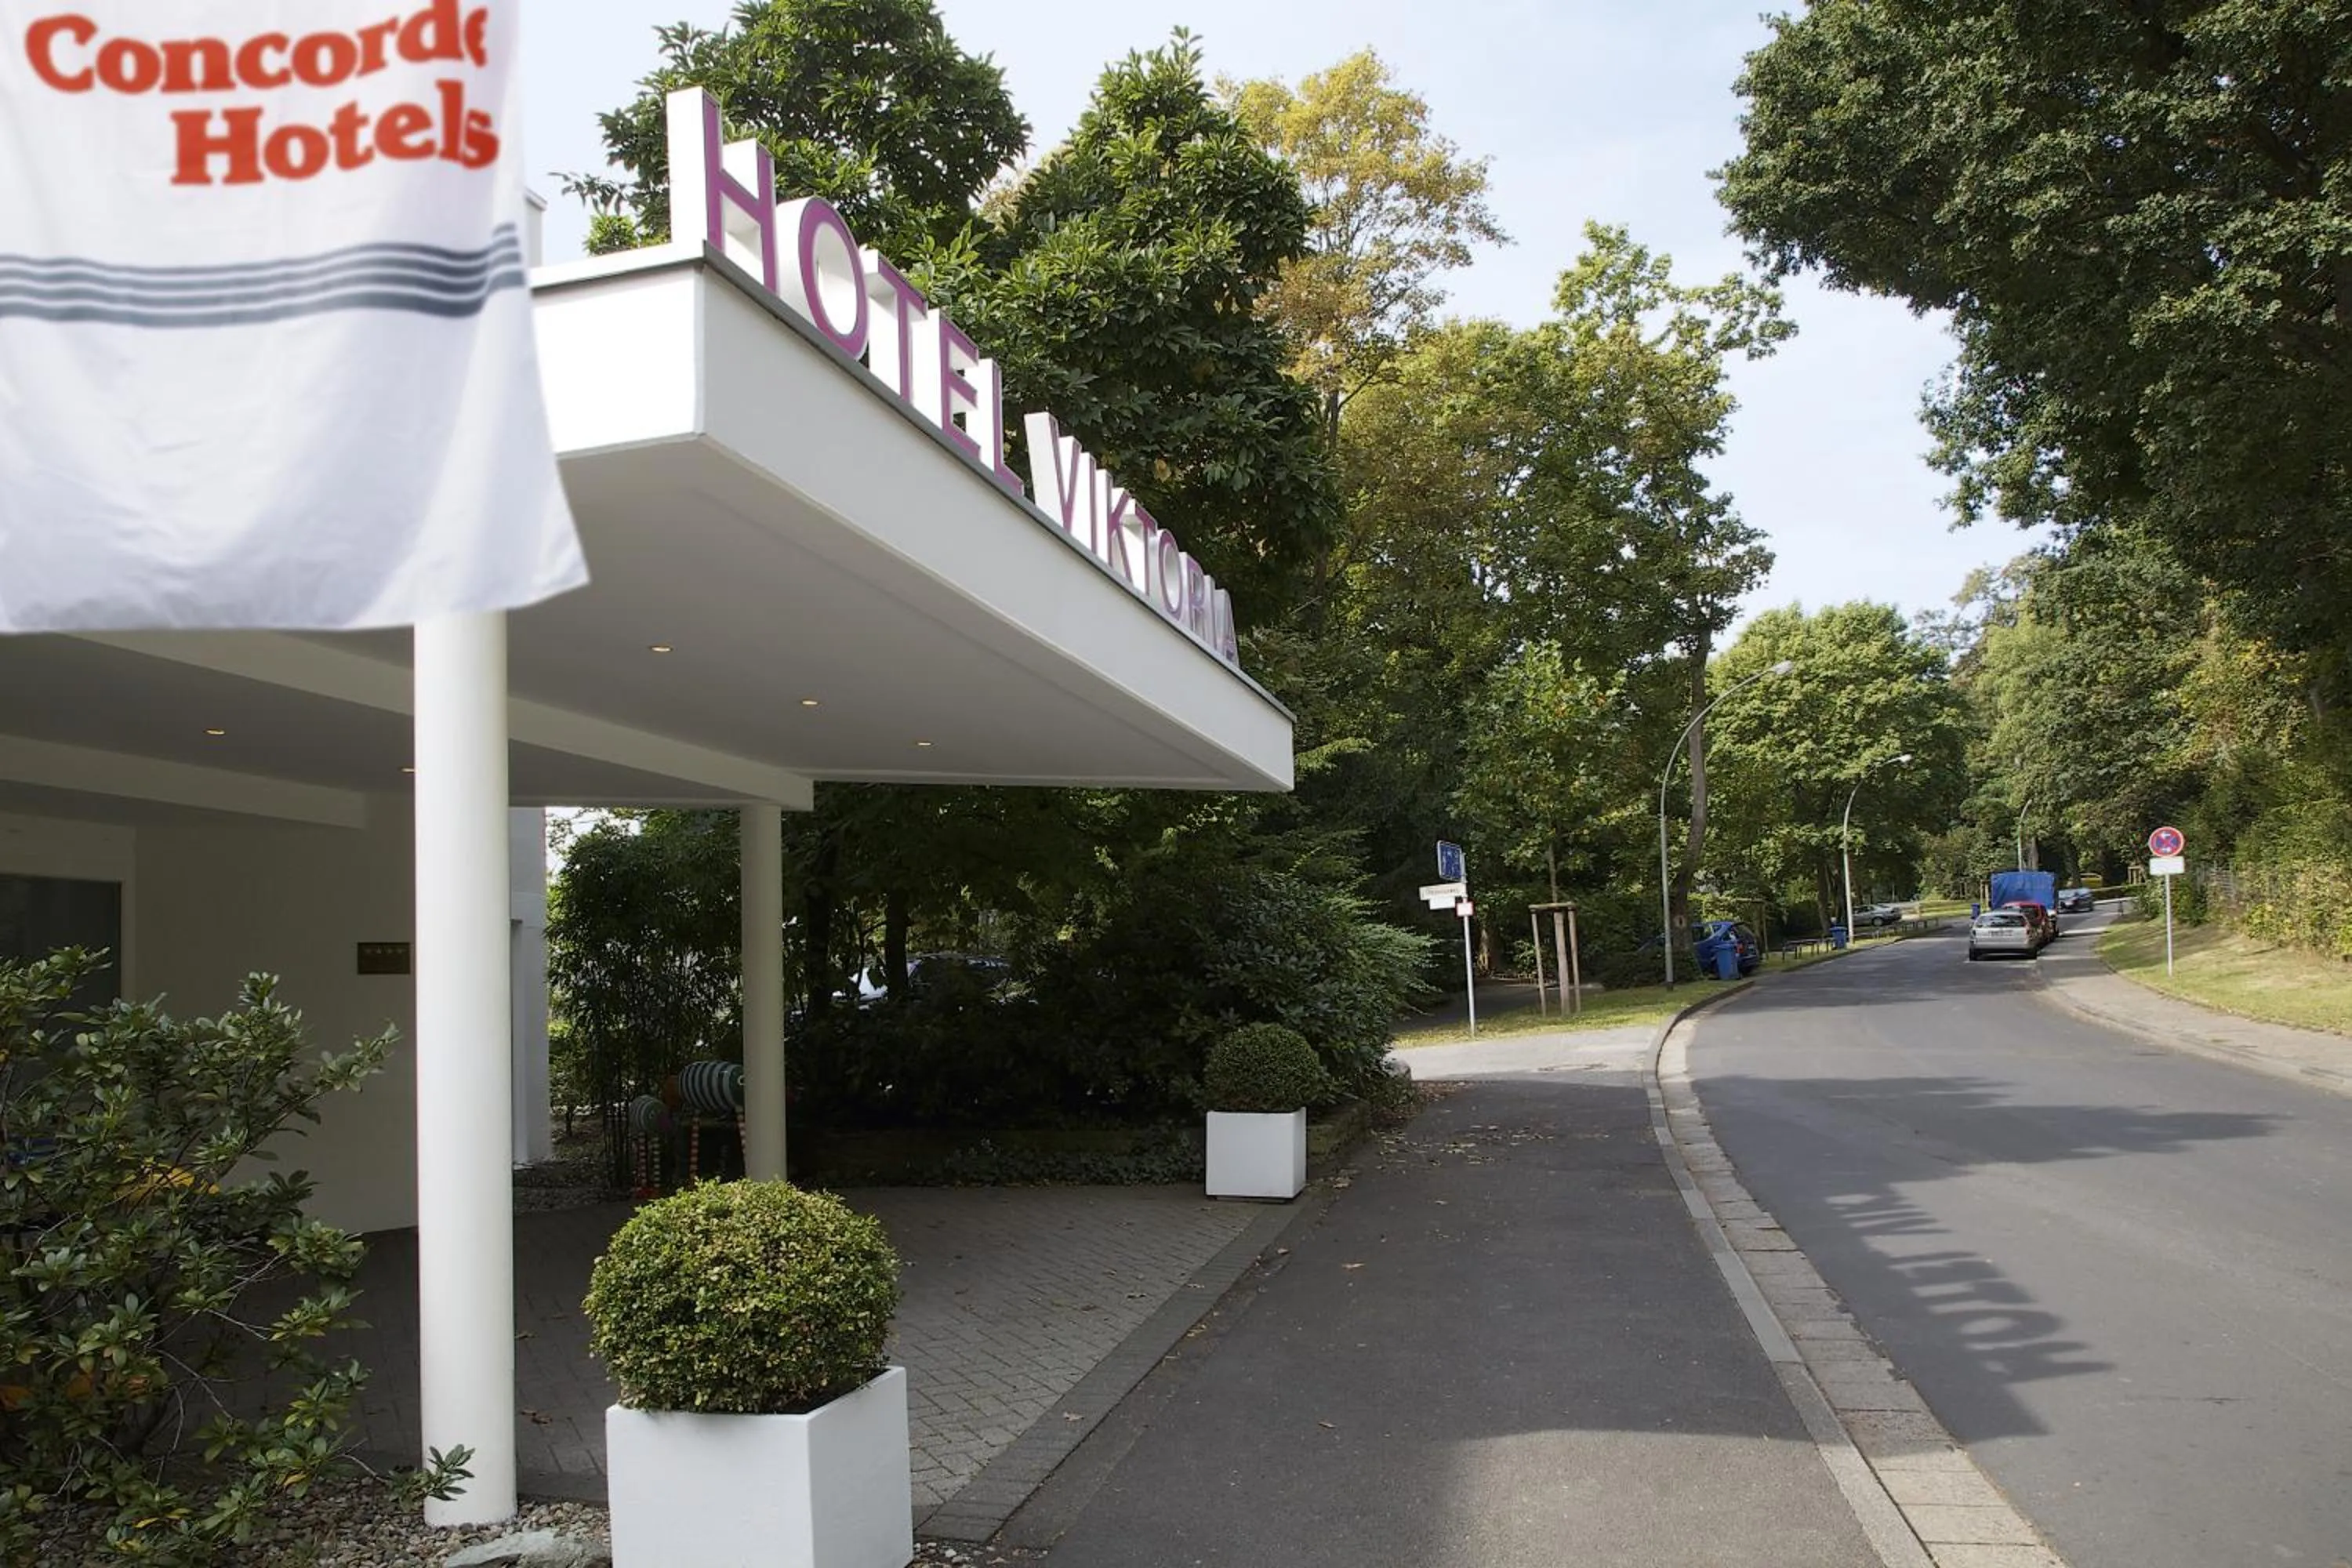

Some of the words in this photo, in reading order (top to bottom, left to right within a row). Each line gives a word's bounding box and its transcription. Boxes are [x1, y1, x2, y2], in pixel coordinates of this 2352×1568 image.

[170, 78, 500, 185] Hotels
[671, 86, 1025, 497] HOTEL
[1025, 412, 1240, 666] VIKTORIA
